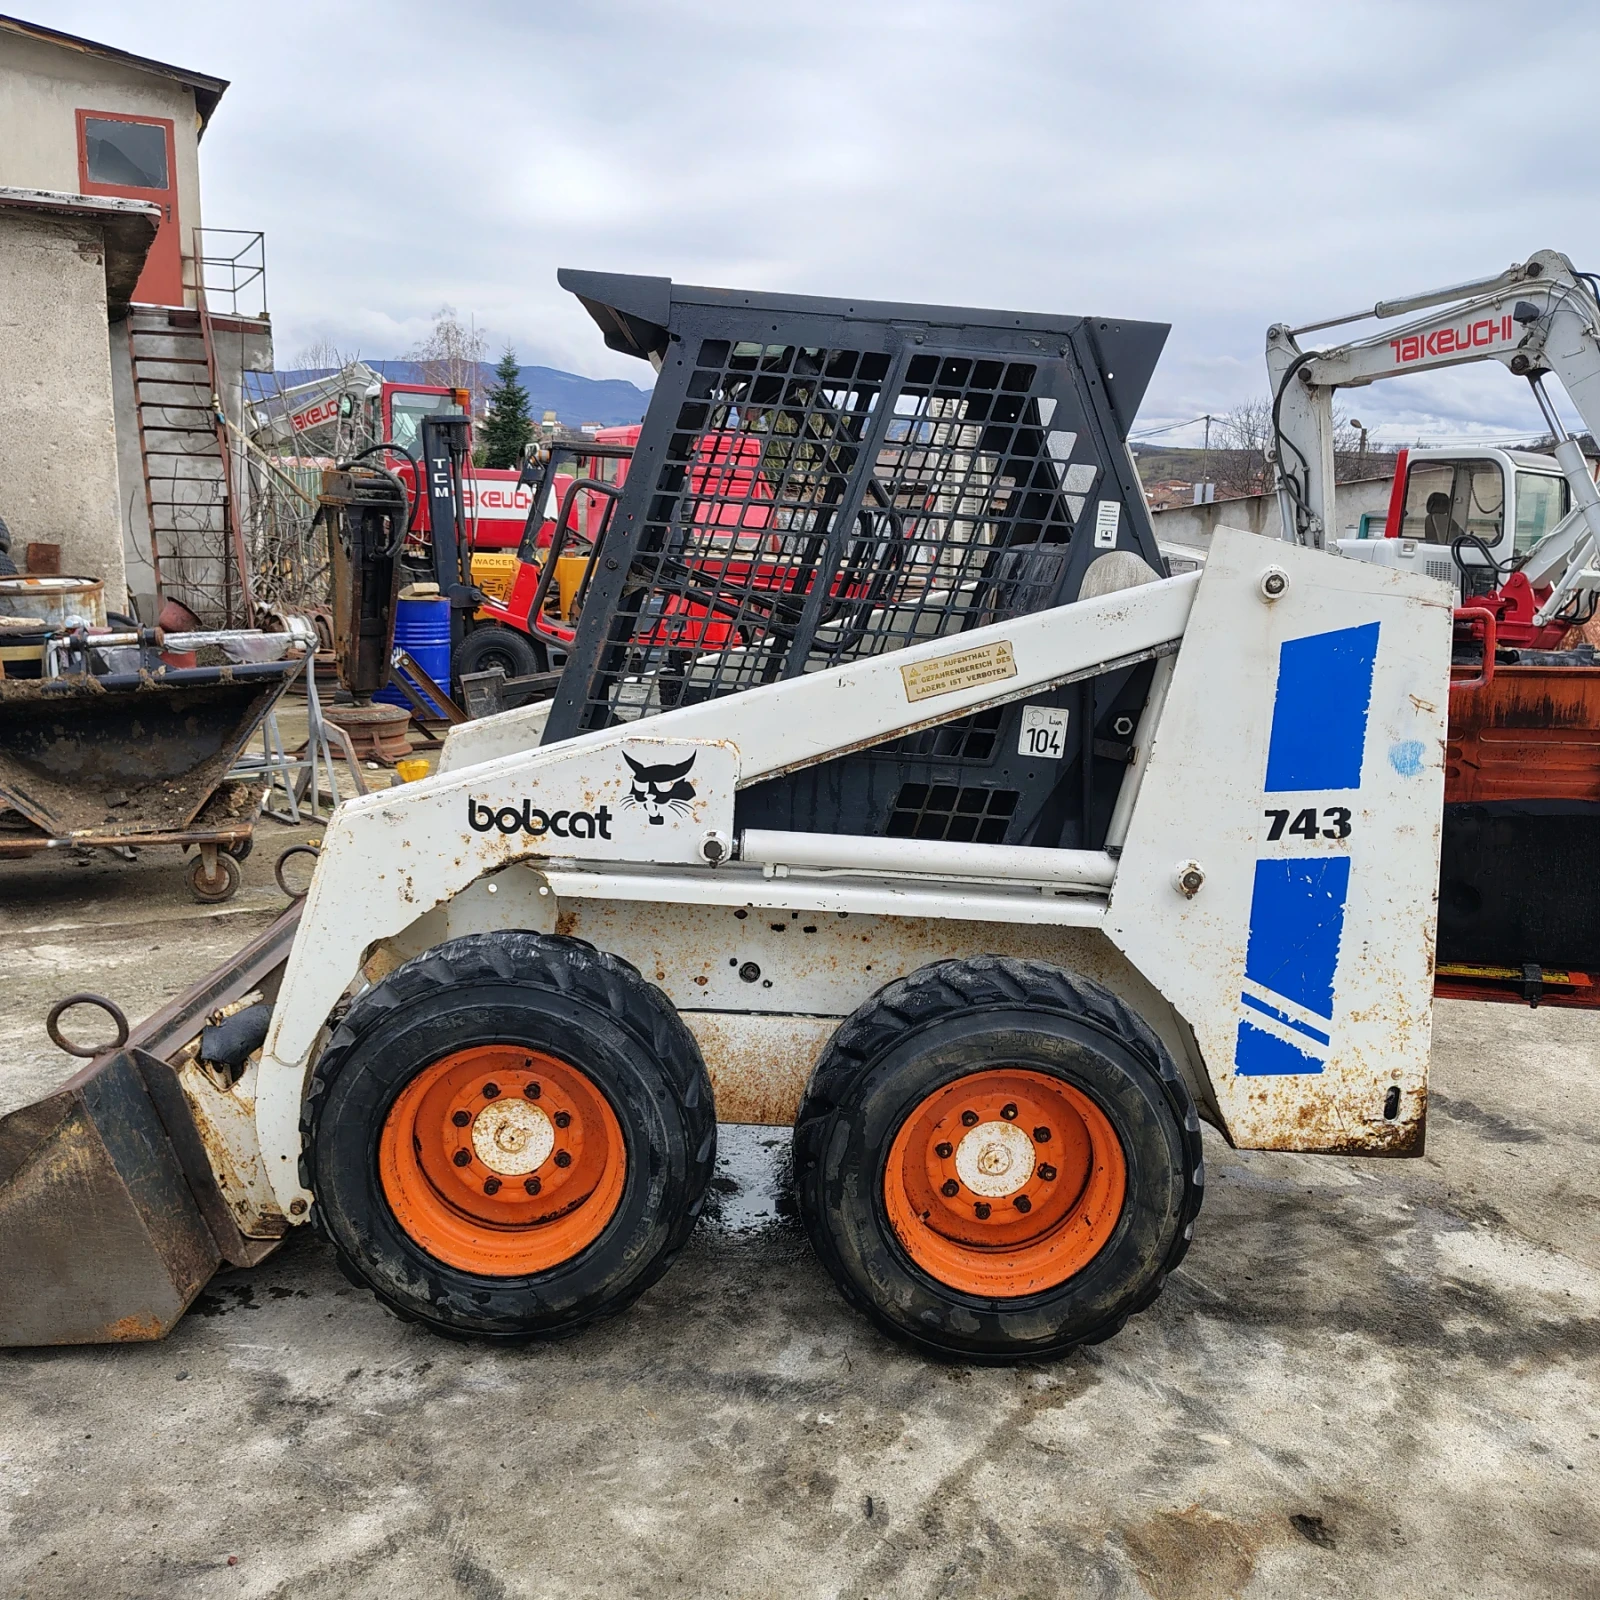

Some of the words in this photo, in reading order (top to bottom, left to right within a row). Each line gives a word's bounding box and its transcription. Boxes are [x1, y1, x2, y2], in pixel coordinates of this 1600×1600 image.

[1390, 315, 1512, 364] TAKEUCHI
[432, 458, 449, 498] TCM
[474, 558, 515, 566] WACKER
[921, 660, 993, 683] GEFAHRENBEREICH
[996, 655, 1011, 665] DES
[923, 662, 939, 672] DER
[943, 650, 991, 667] AUFENTHALT
[916, 683, 946, 695] LADERS
[950, 678, 962, 686] IST
[966, 667, 1007, 682] VERBOTEN
[1026, 728, 1060, 754] 104
[468, 794, 613, 840] bobcat
[1264, 807, 1352, 841] 743
